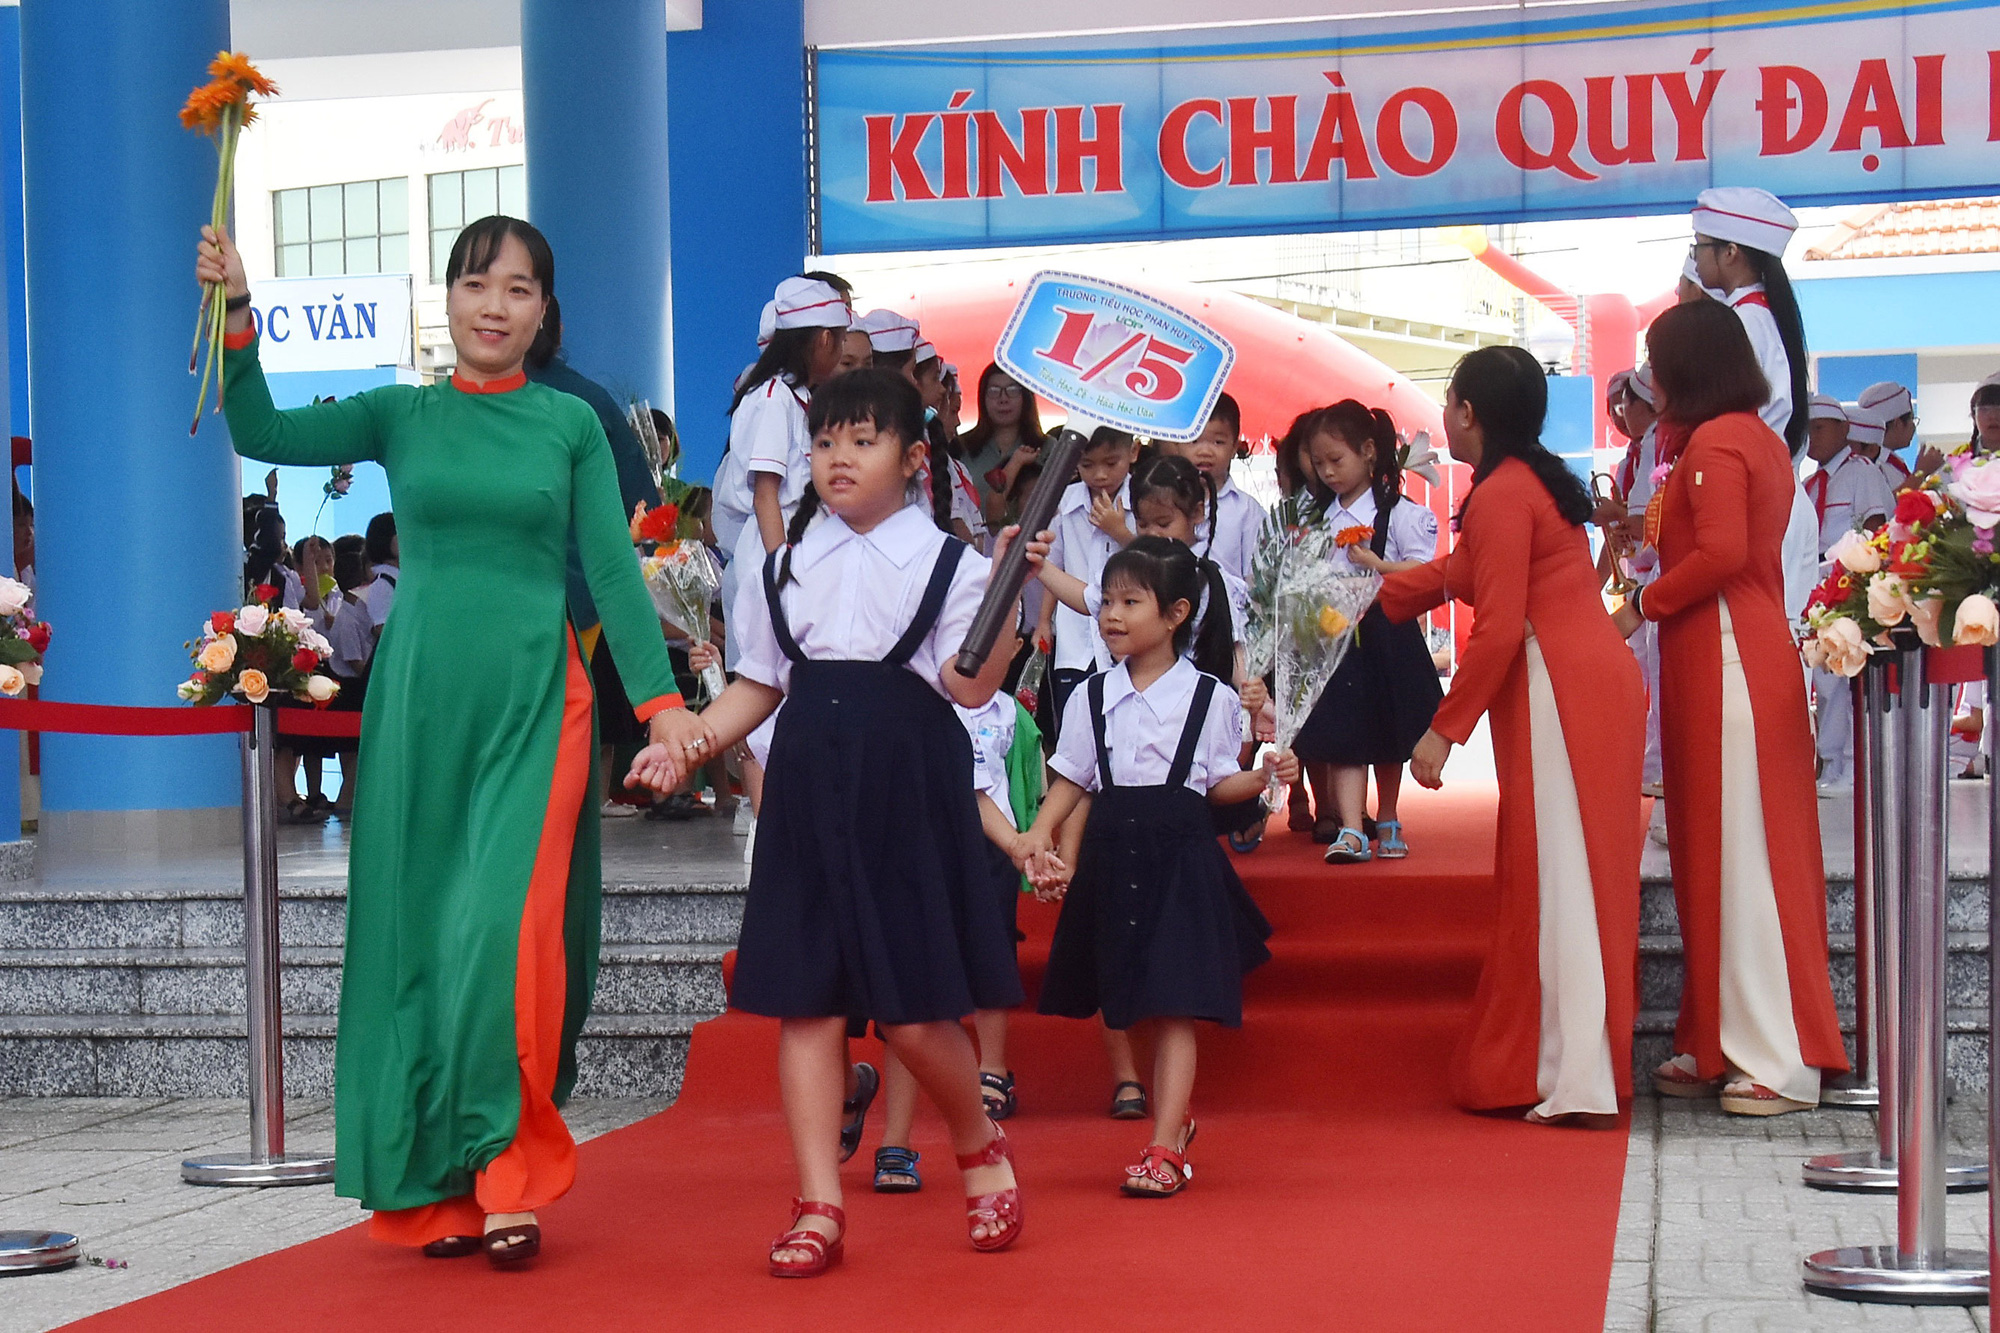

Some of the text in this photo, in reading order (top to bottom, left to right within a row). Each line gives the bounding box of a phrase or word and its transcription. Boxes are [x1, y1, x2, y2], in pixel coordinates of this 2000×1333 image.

[864, 90, 1125, 203] KÍNH
[1158, 71, 1458, 189] CHÀO
[1496, 48, 1726, 181] QUÝ
[1755, 54, 1946, 172] ĐẠI
[303, 293, 377, 340] VĂN
[1144, 313, 1170, 330] PHAN
[1170, 326, 1189, 340] HUY
[1036, 307, 1194, 402] 1/5
